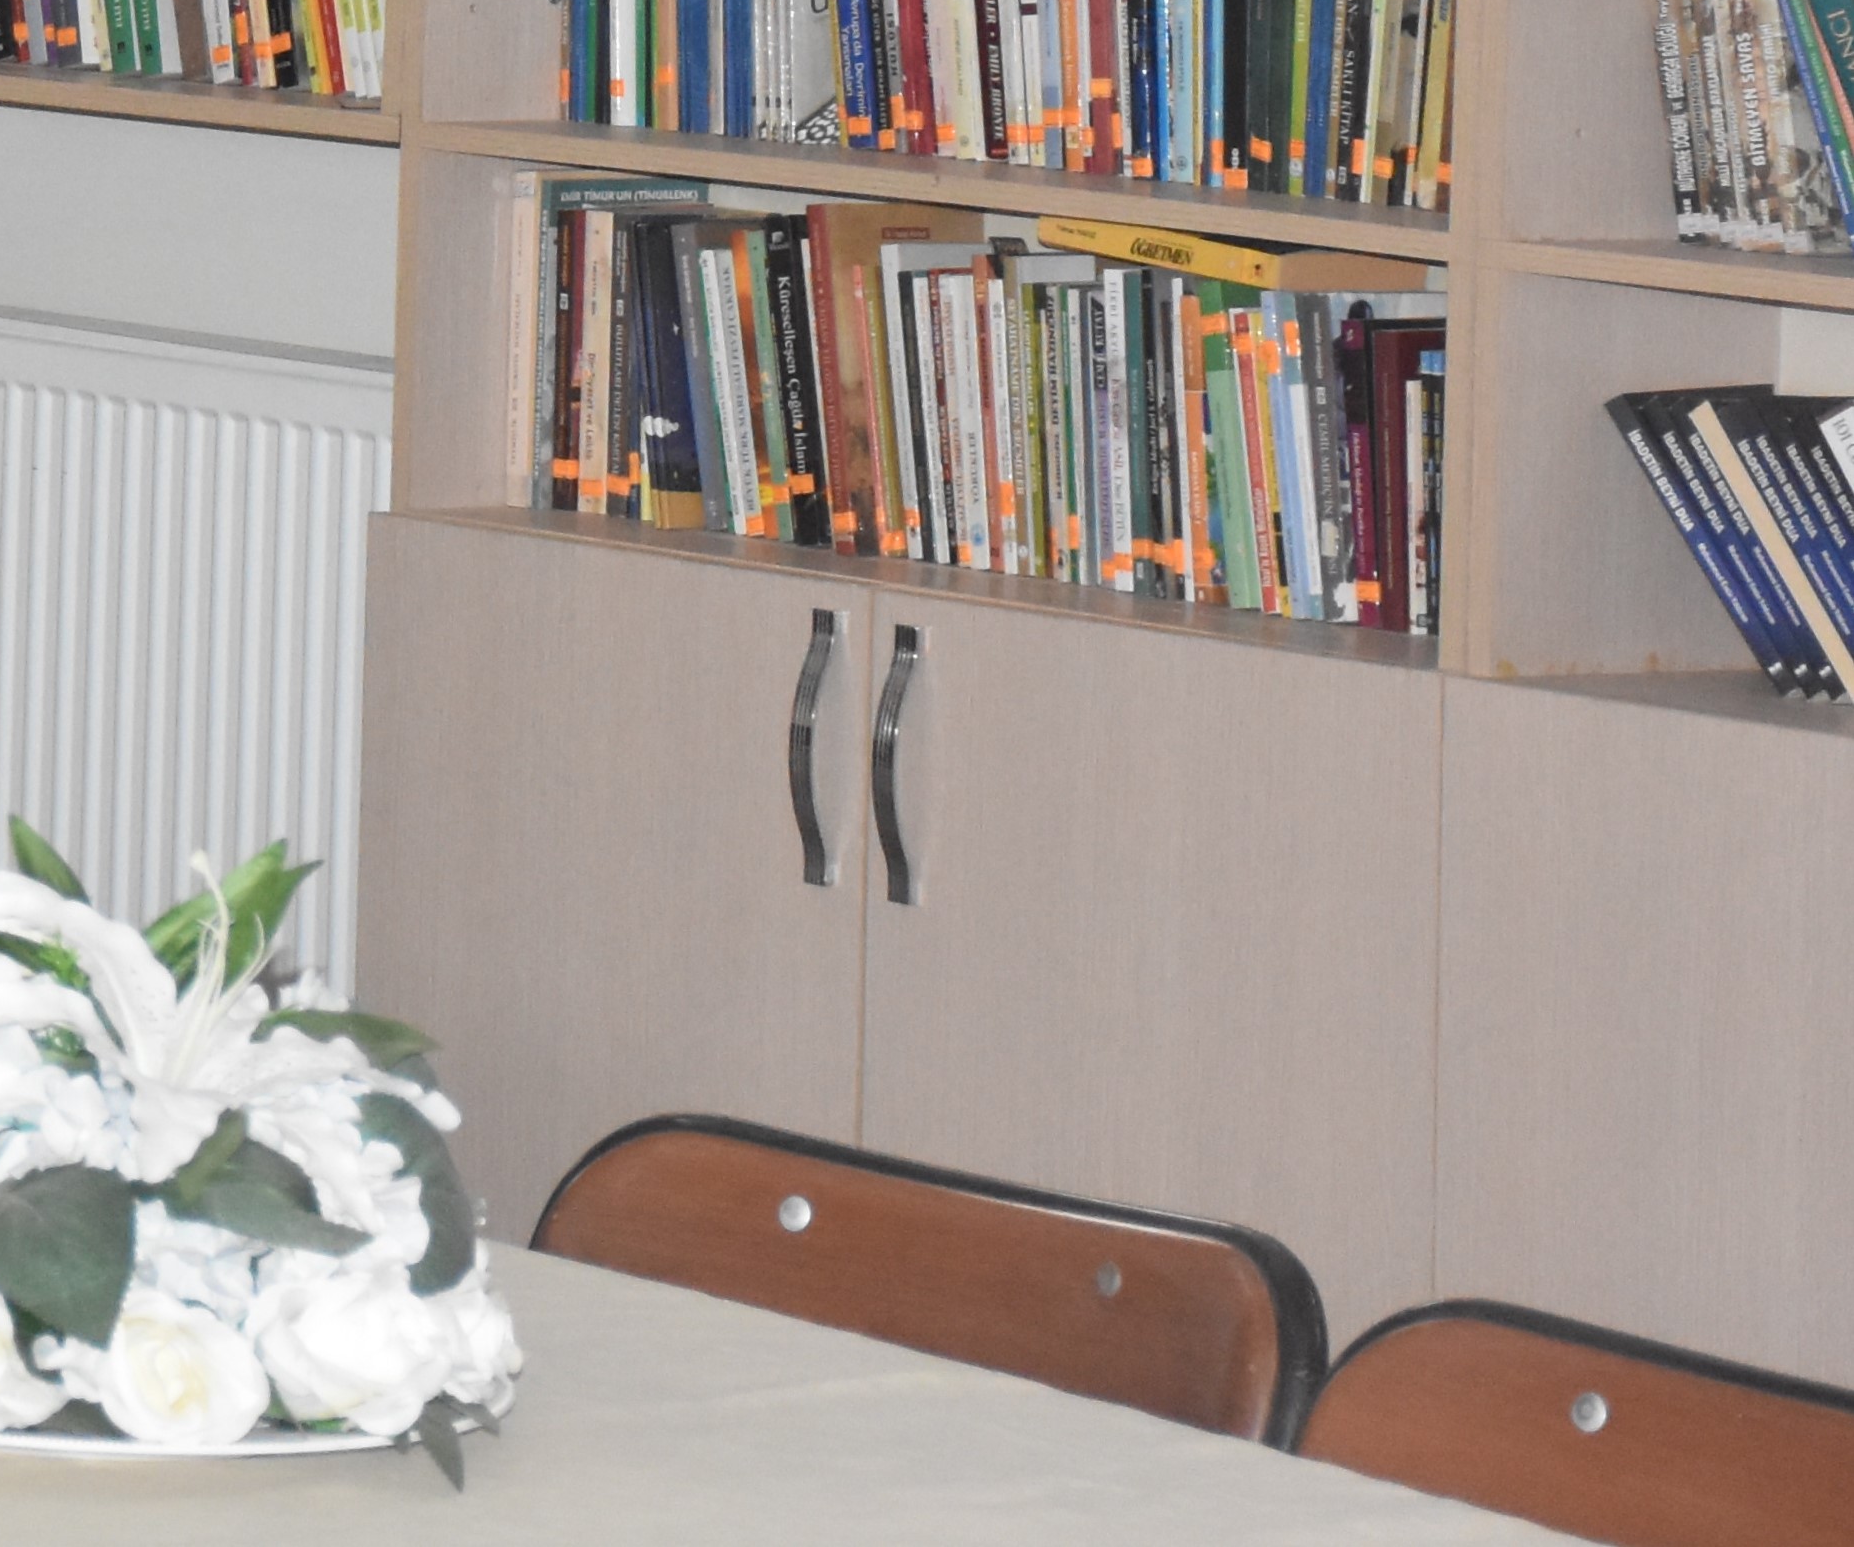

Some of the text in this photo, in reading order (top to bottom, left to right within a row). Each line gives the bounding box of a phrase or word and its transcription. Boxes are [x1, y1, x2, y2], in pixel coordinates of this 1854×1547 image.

[113, 5, 124, 27] ELLİ
[141, 7, 151, 29] ELLİ
[840, 26, 853, 95] Yansımaları
[853, 36, 862, 55] da
[987, 43, 1001, 82] EMILY
[855, 62, 867, 116] Devrimin
[1342, 50, 1355, 101] SAKLI
[1736, 32, 1766, 165] BİTMEYEN SAVAŞ
[1339, 107, 1352, 144] KİTAP
[1130, 237, 1193, 266] ÖĞRETMEN
[721, 266, 737, 320] ÇAKMAK
[1092, 308, 1105, 345] KUTAY
[776, 275, 799, 373] Küreselleşen
[793, 431, 810, 473] İslam
[738, 431, 751, 463] TÜRK
[1318, 413, 1330, 450] CEMİL
[741, 468, 756, 511] BÜYÜK
[1626, 428, 1664, 479] İBADETİN
[1654, 475, 1682, 510] BEYNİ
[1672, 505, 1696, 533] DUA
[1661, 430, 1697, 481] İBADETİN
[1687, 477, 1713, 511] BEYNİ
[1704, 508, 1726, 534] DUA
[1688, 431, 1752, 536] İBADETİN BEYNİ DUA
[1736, 438, 1802, 543] İBADETİN BEYNİ DUA
[1755, 434, 1820, 539] İBADETİN BEYNİ DUA
[1809, 445, 1843, 495] İBADETİN
[1785, 443, 1848, 549] İBADETİN BEYNİ DUA
